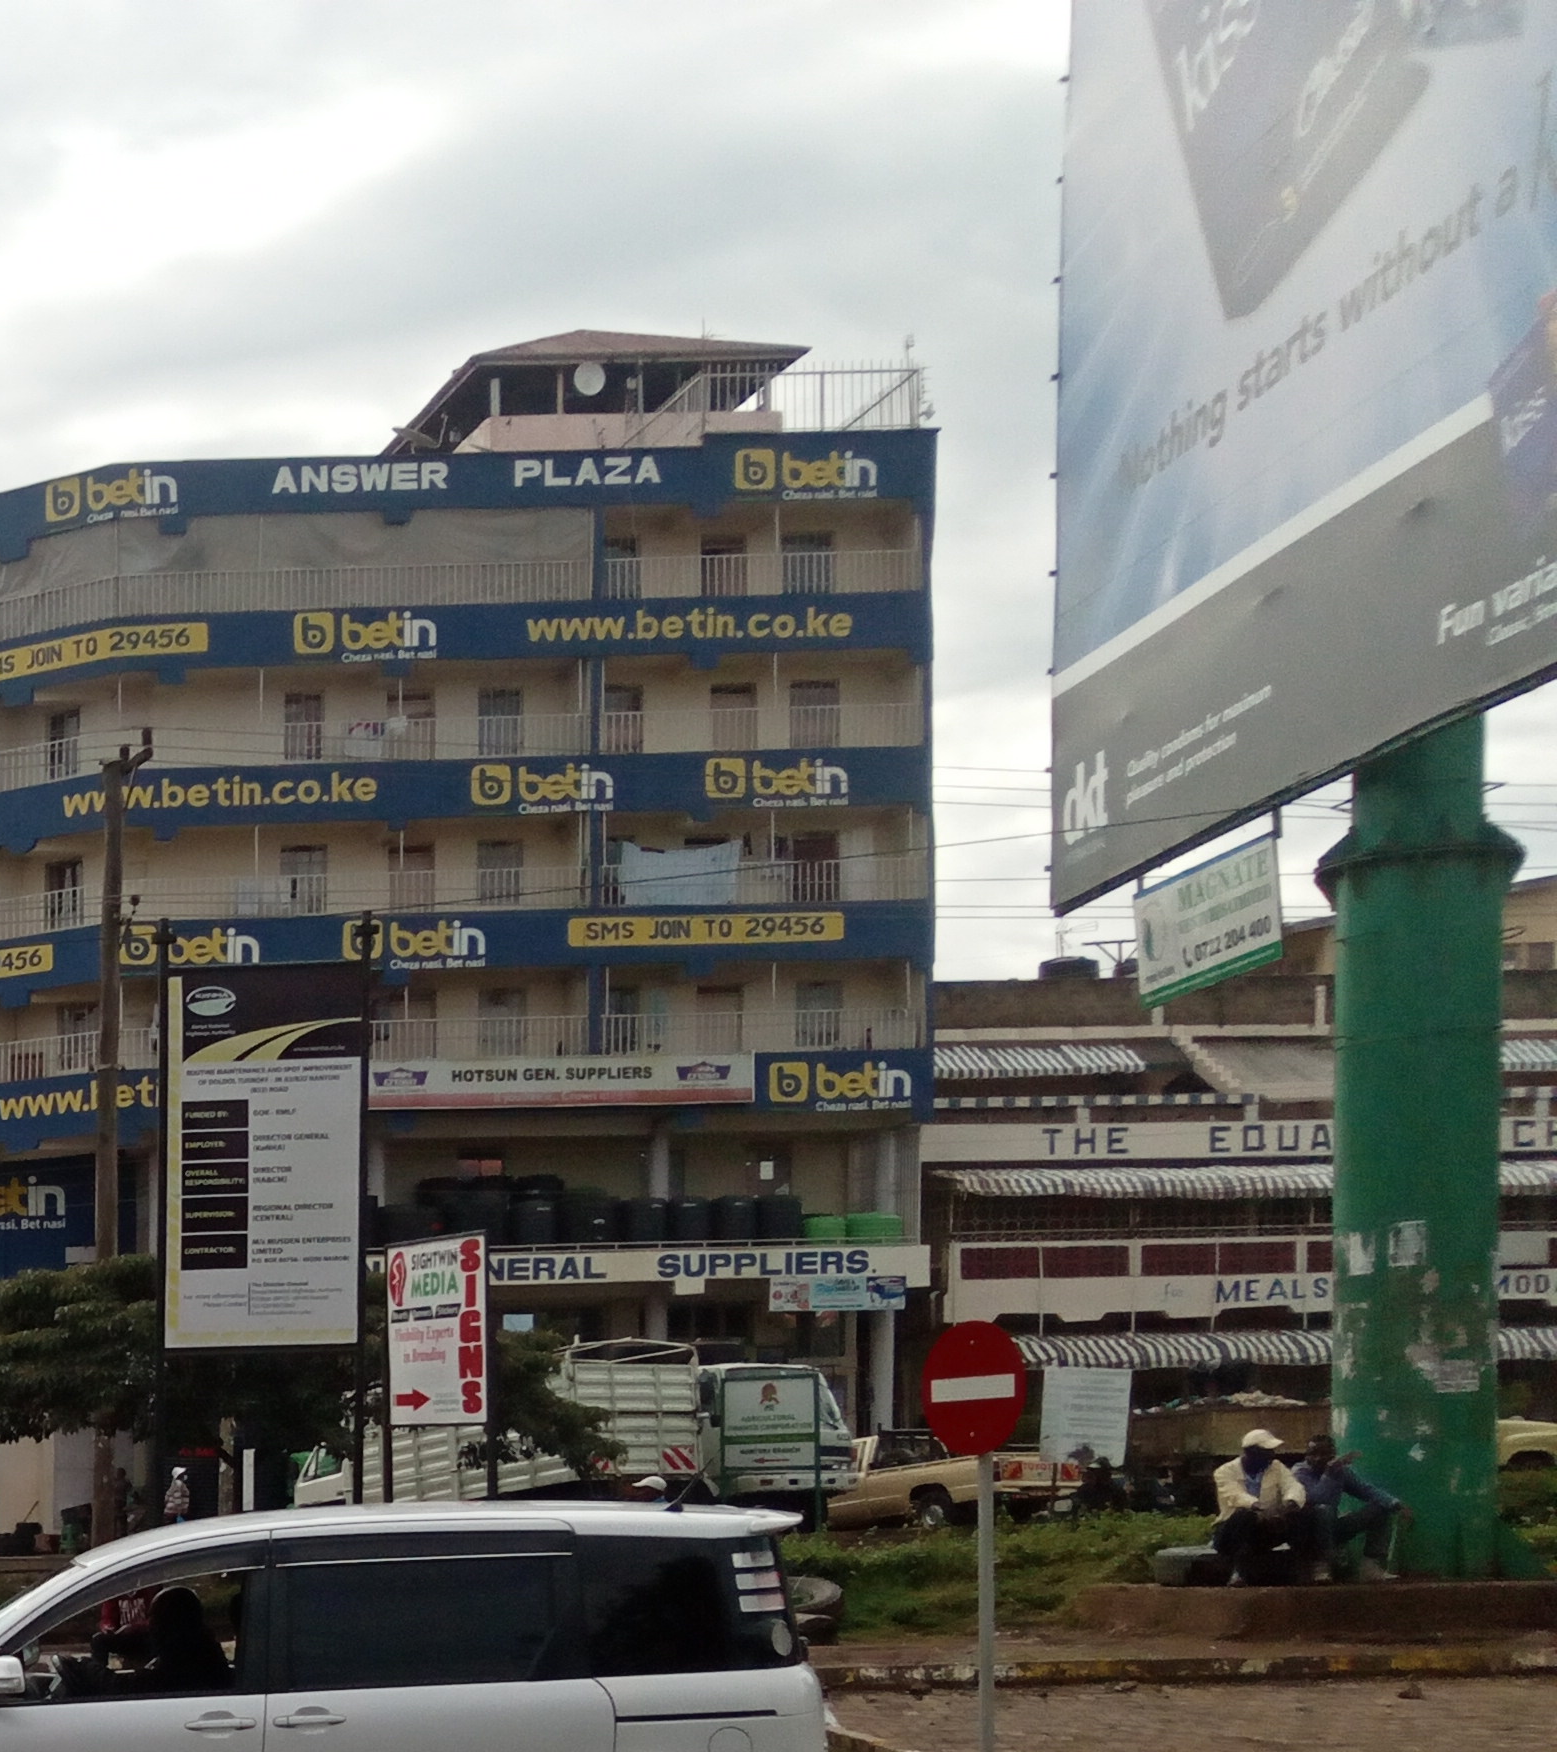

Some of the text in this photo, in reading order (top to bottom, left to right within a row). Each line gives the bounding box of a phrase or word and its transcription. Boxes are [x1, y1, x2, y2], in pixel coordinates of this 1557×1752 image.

[1237, 311, 1328, 411] starts
[1339, 183, 1480, 331] without
[272, 456, 661, 494] ANSWER PLAZA
[782, 451, 878, 489] betin
[86, 468, 178, 511] betin
[342, 612, 437, 650] betin
[526, 607, 853, 642] www.betin.co.ke
[27, 645, 63, 670] JOIN
[72, 639, 97, 658] TO
[109, 627, 191, 651] 29456
[518, 763, 613, 801] betin
[753, 758, 848, 796] betin
[1177, 848, 1270, 912] MAGNATE
[168, 928, 259, 964] betin
[390, 920, 485, 957] betin
[586, 917, 825, 940] SMS JOIN TO 29456
[1194, 935, 1222, 962] 0722
[451, 1066, 652, 1083] HOTSUN GEN. SUPPLIERS
[816, 1062, 911, 1098] betin
[294, 1132, 329, 1140] GENERAL
[1042, 1127, 1129, 1154] THE
[1209, 1124, 1331, 1153] EQUA
[411, 1250, 458, 1271] SIGHTWIN
[489, 1250, 876, 1281] NERAL SUPPLIERS.
[411, 1272, 459, 1299] MEDIA
[1216, 1278, 1328, 1303] MEALS
[459, 1238, 483, 1414] SIGNS
